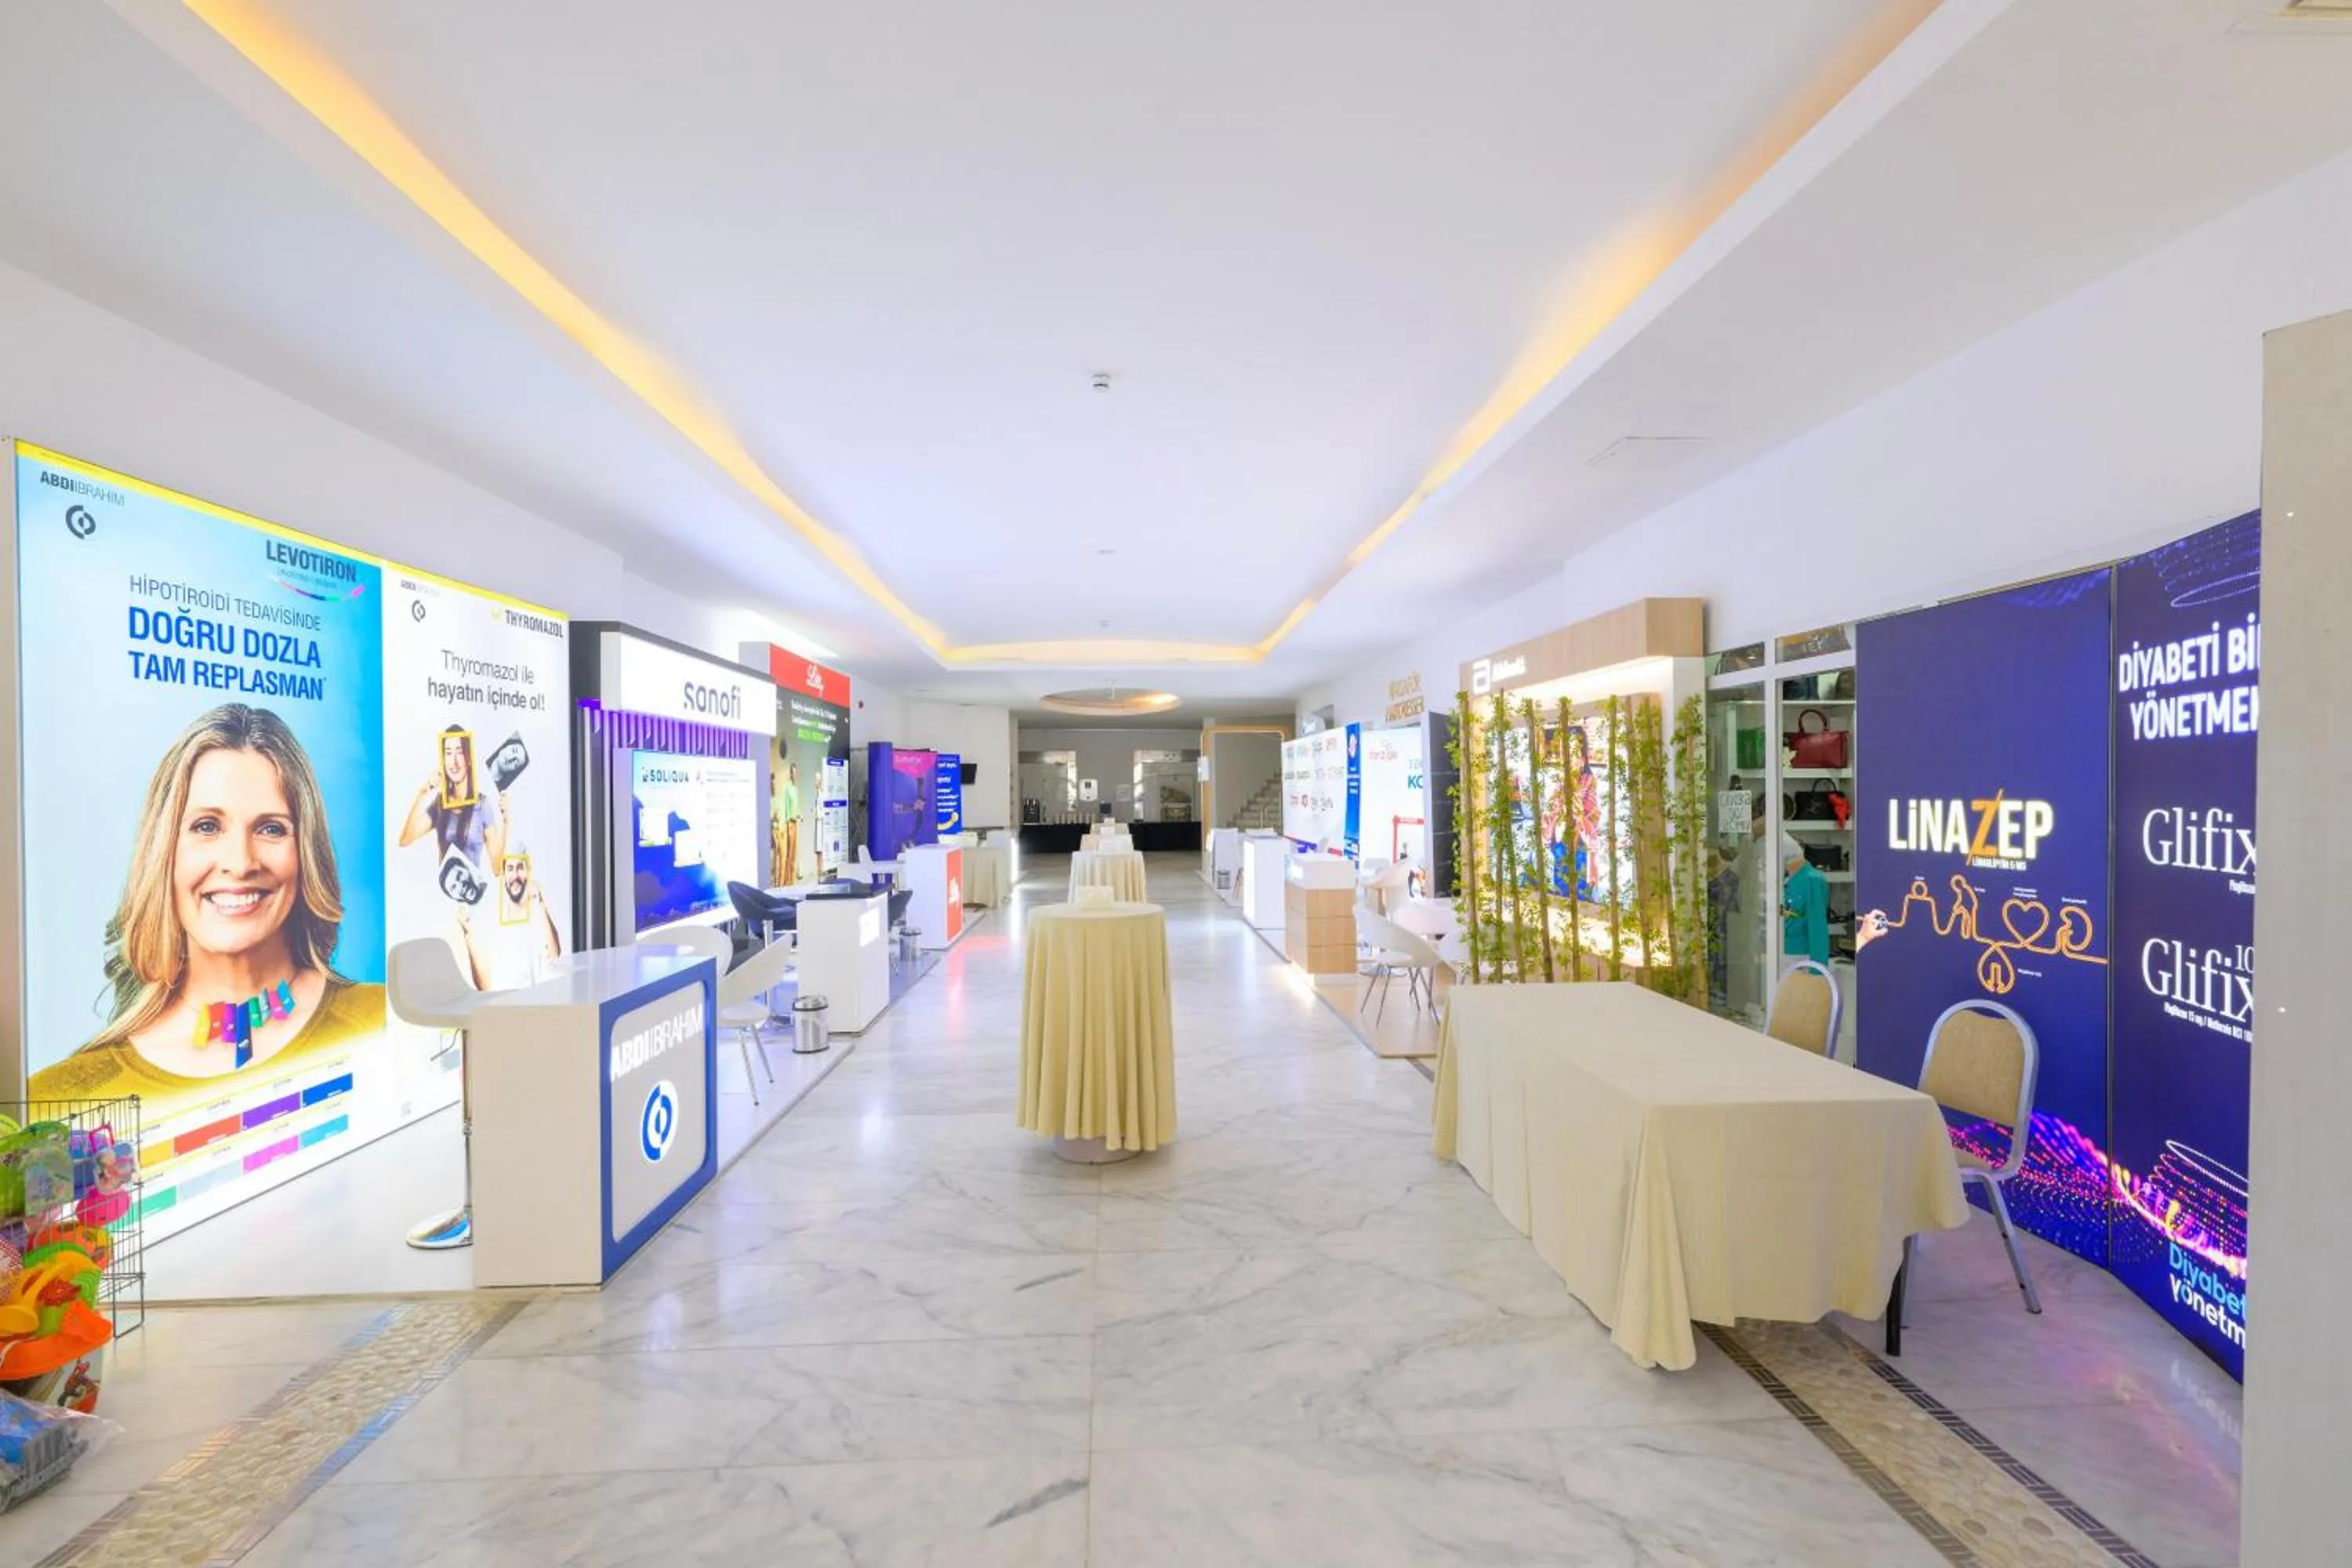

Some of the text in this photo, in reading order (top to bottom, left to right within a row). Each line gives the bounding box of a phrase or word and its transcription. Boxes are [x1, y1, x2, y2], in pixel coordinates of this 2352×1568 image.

[266, 539, 356, 583] LEVOTIRON
[129, 573, 321, 631] HİPOTİROİDİ TEDAVİSİNDE
[505, 609, 564, 638] THYROMAZOL
[129, 605, 321, 668] DOĞRU DOZLA
[2119, 612, 2260, 691] DİYABETİ Bİ
[128, 650, 185, 684] TAM
[441, 648, 535, 684] Thyromazol ile
[427, 677, 484, 704] hayatın
[486, 684, 527, 710] içinde
[684, 681, 741, 720] sanofi
[2143, 807, 2256, 875] Glifix
[2141, 938, 2254, 1023] Glifix
[2169, 1241, 2247, 1321] Diyabet
